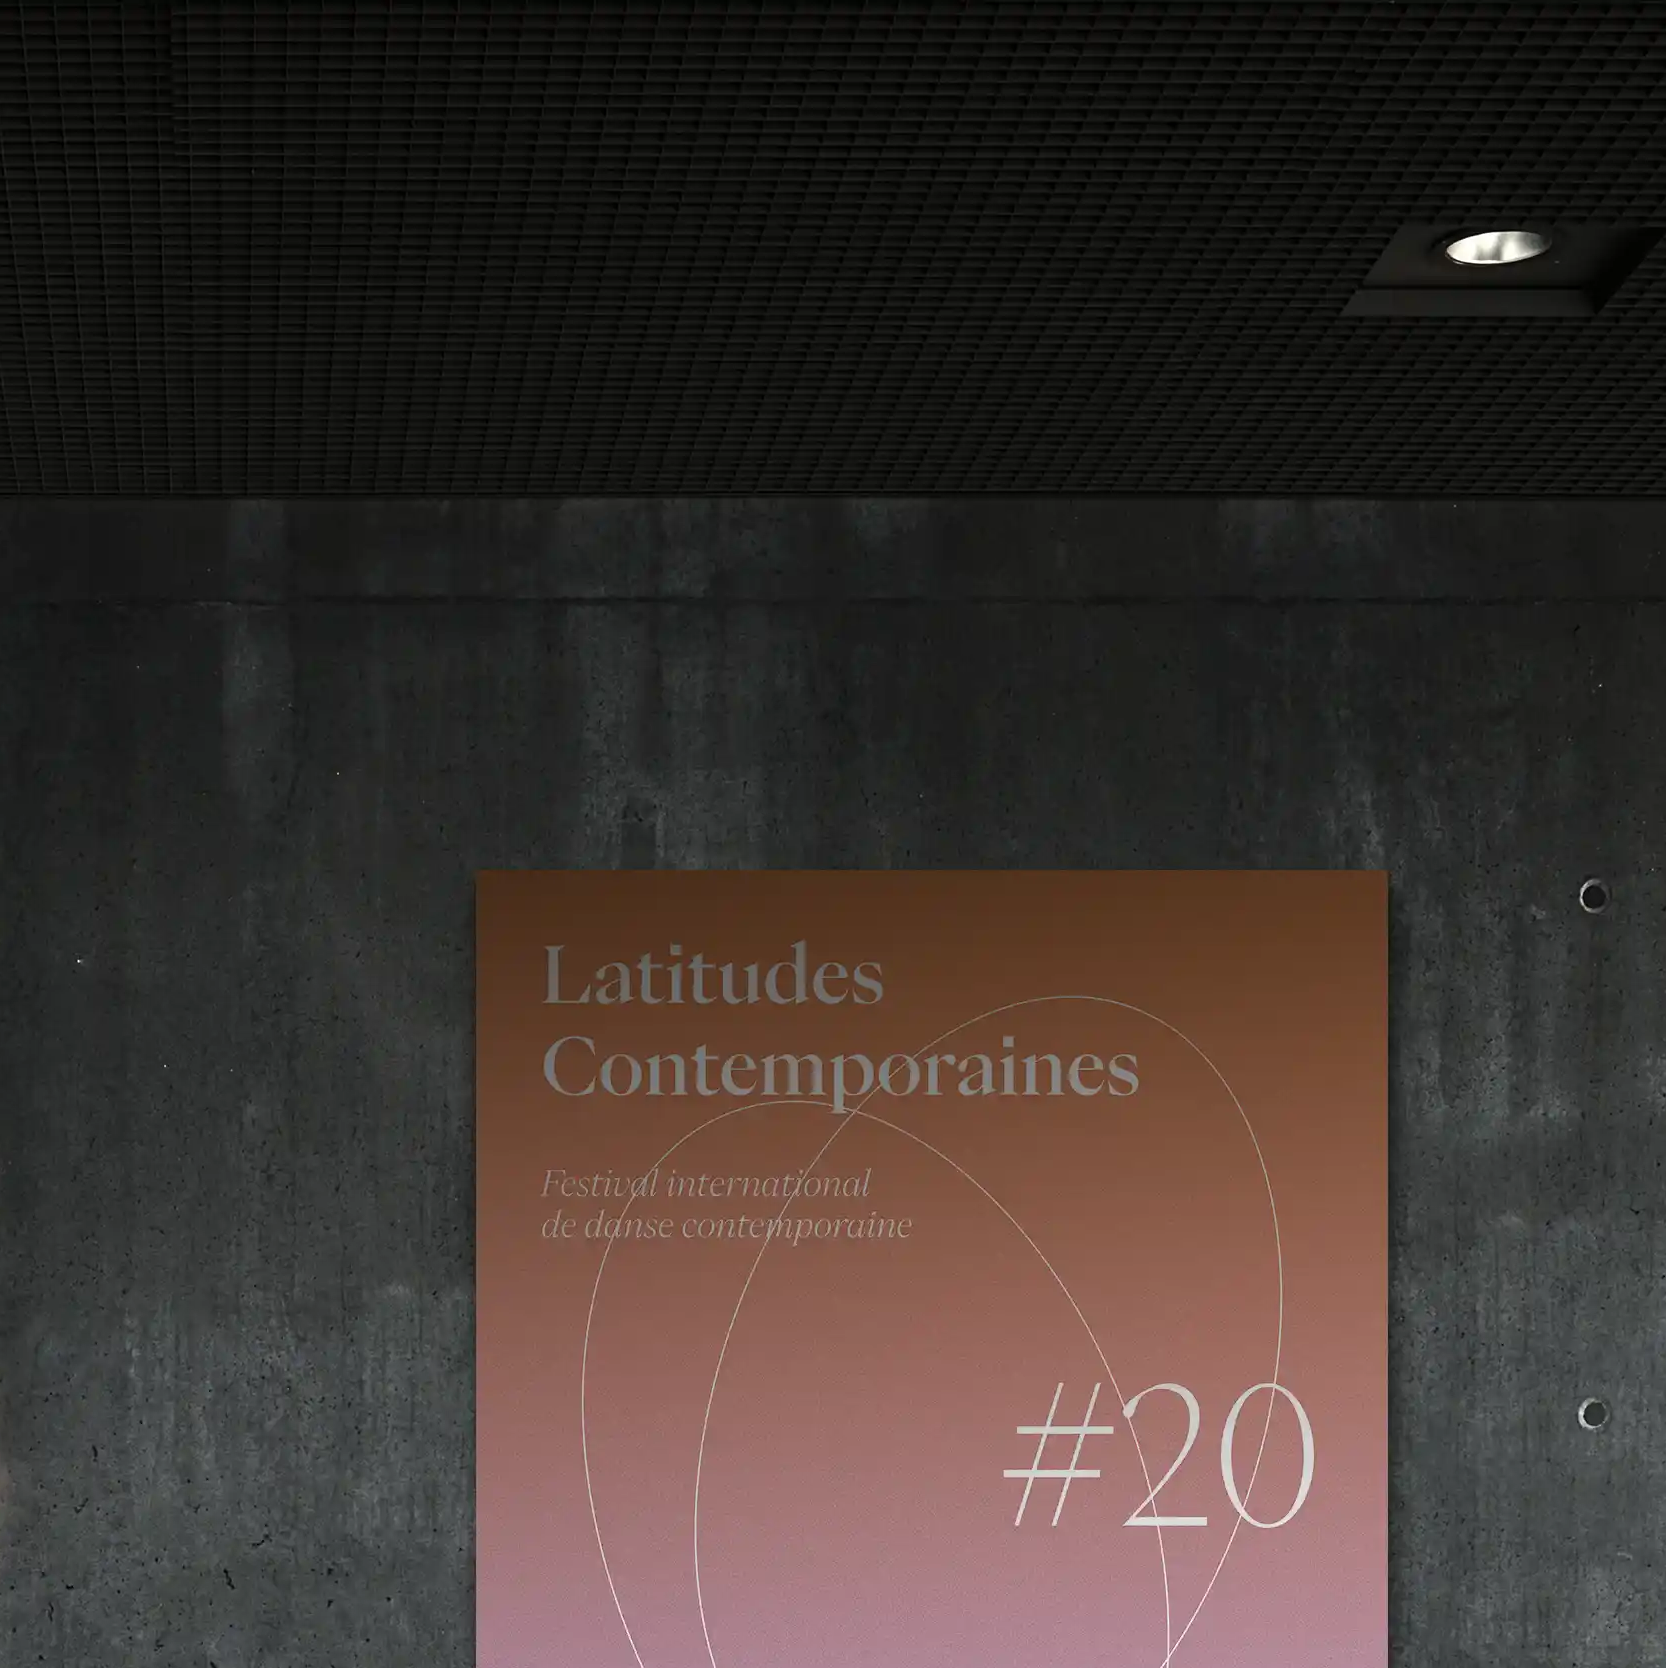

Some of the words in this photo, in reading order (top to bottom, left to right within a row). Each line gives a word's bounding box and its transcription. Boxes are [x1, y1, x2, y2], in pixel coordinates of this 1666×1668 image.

[544, 939, 884, 1005] Latitudes
[543, 1035, 1140, 1114] Contemporaines
[541, 1168, 659, 1197] Festival
[667, 1168, 872, 1197] international
[541, 1209, 577, 1238] de
[584, 1209, 674, 1238] danse
[682, 1212, 913, 1246] contemporaine
[1003, 1382, 1316, 1529] #20
